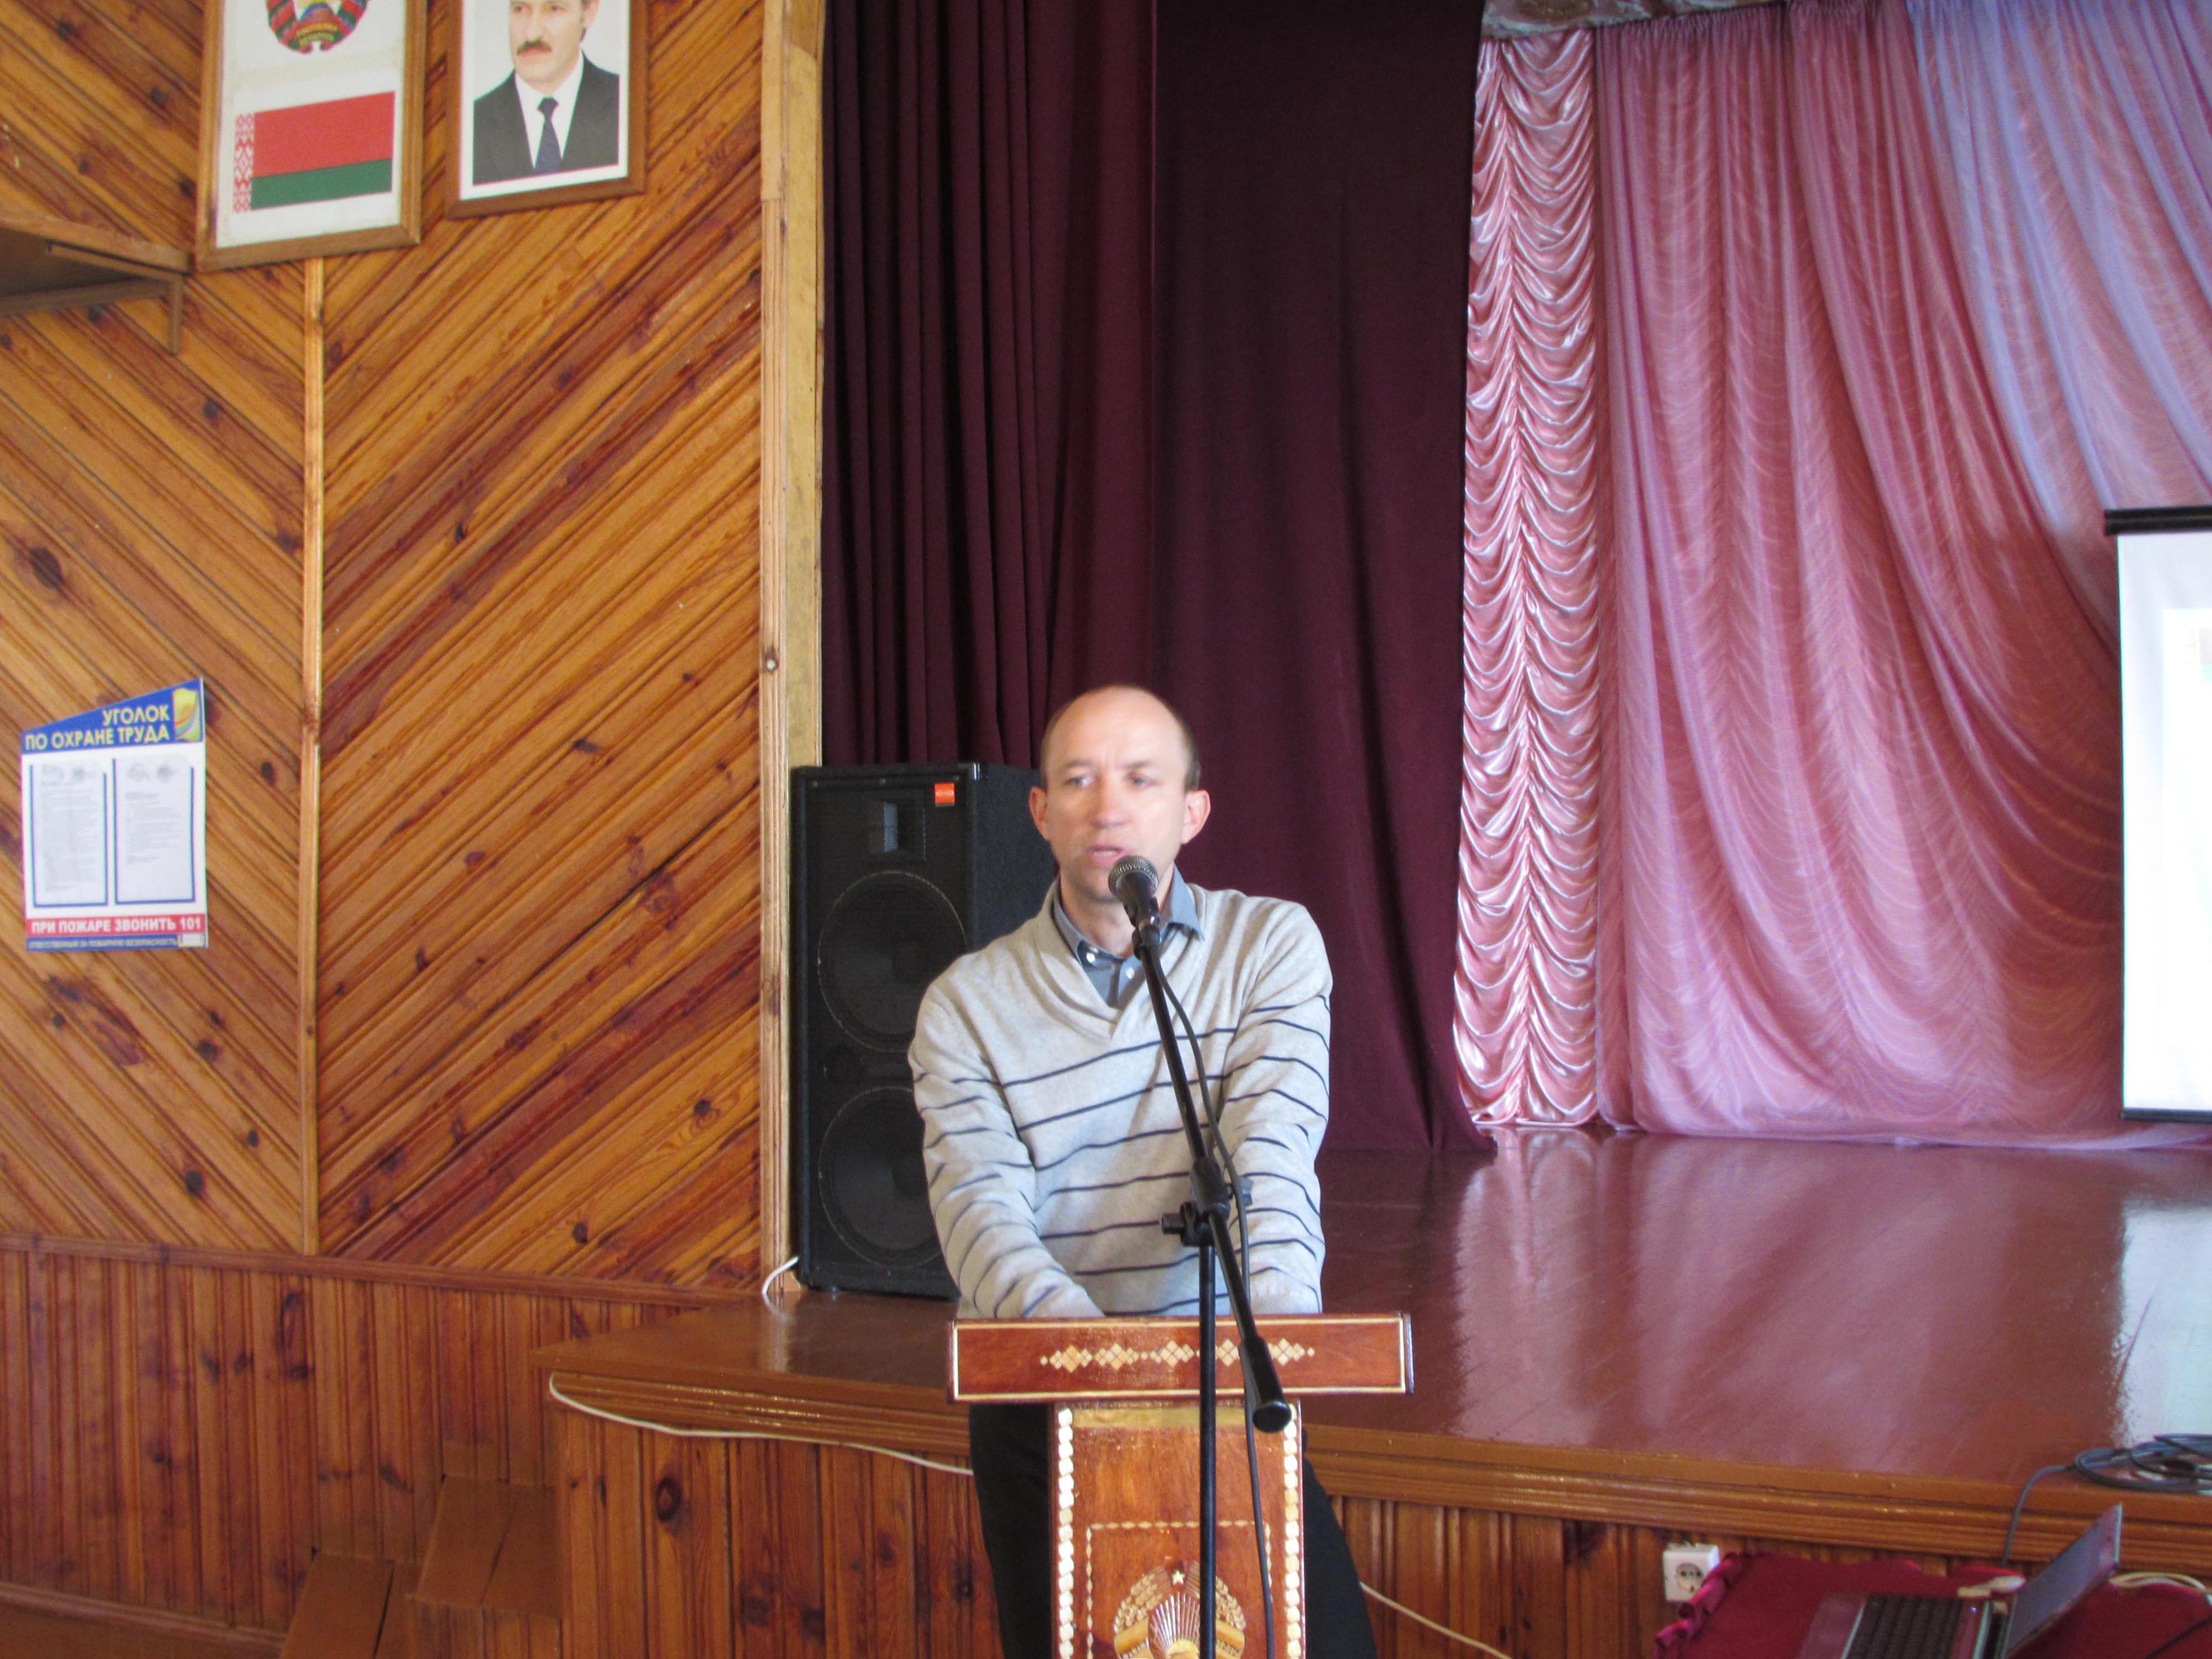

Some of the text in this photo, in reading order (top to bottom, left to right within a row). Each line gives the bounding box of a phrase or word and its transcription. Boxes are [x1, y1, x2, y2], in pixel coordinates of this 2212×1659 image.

[102, 705, 170, 727] УГОЛОК
[25, 724, 170, 750] ПО ОХРАНЕ ТРУДА
[31, 917, 201, 934] ПРИ ПОЖАРЕ ЗВОНИТЬ 101
